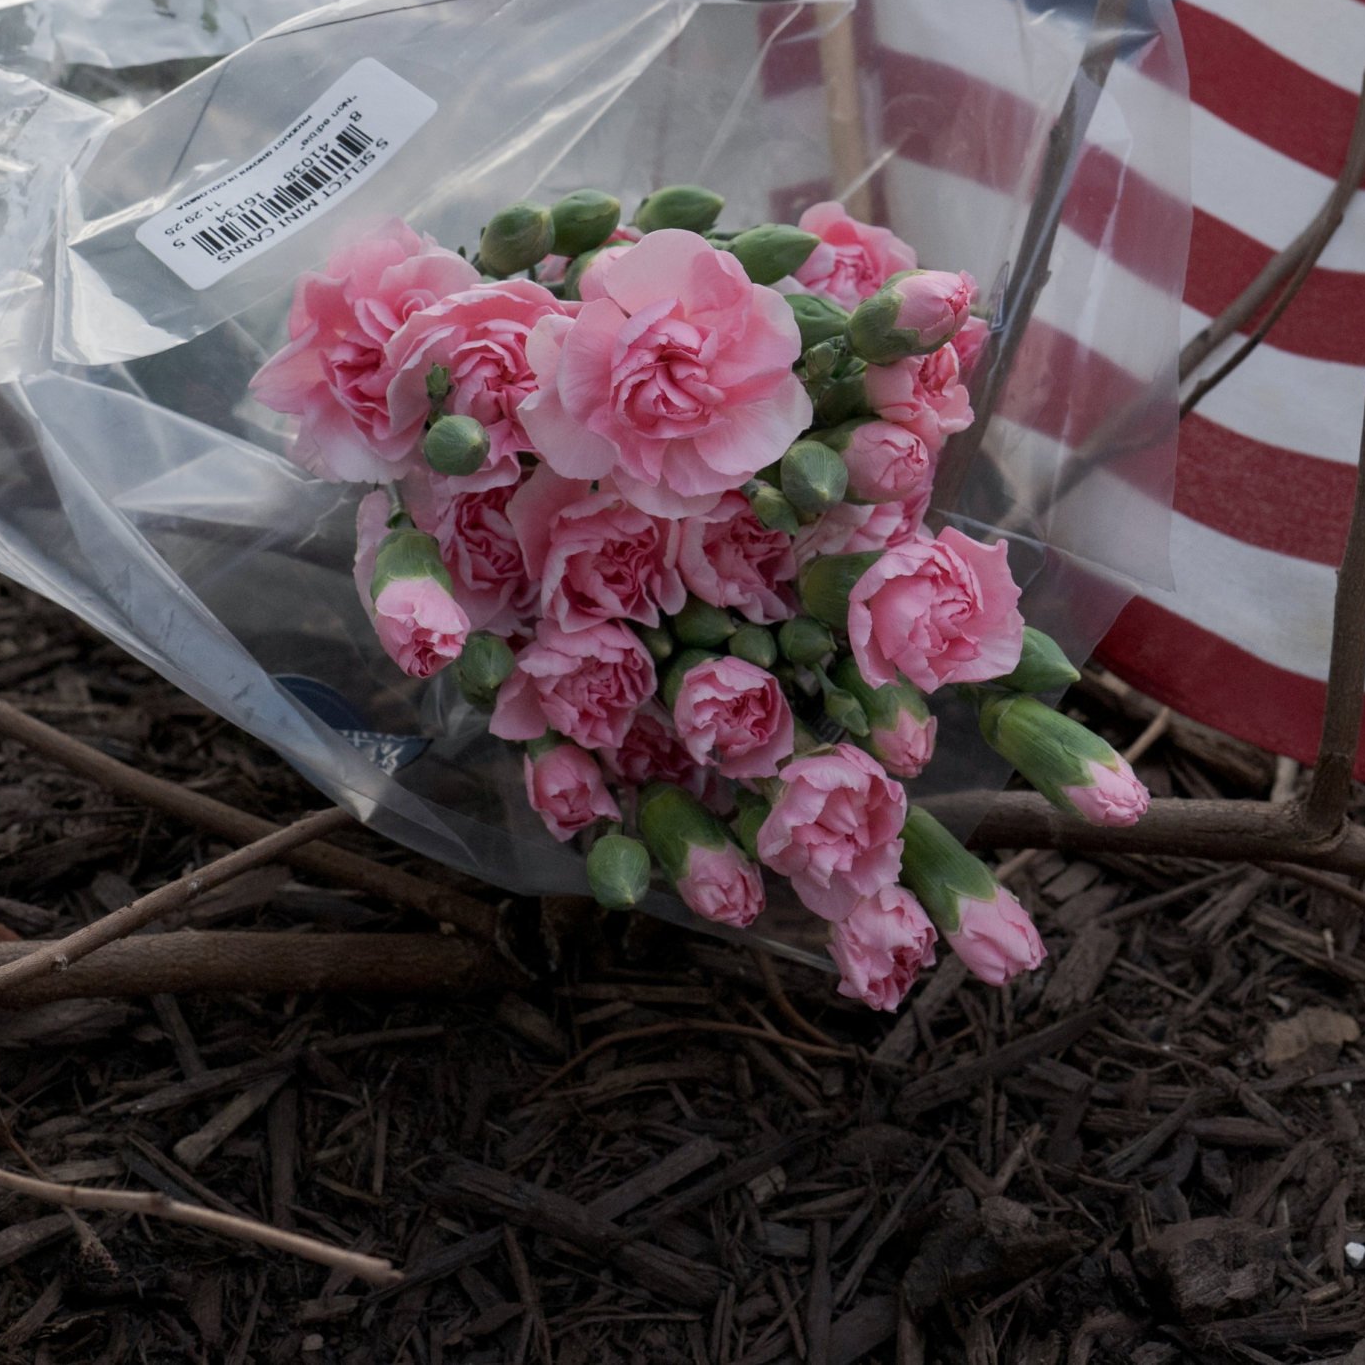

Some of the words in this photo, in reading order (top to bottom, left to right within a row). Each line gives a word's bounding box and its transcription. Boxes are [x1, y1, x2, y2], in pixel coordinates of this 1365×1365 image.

[349, 110, 363, 123] 8
[272, 114, 313, 151] PRODUCT
[375, 138, 389, 151] S
[238, 150, 273, 176] GROWN
[282, 142, 329, 182] 41038
[322, 151, 376, 198] SELECT
[215, 192, 266, 224] 16134
[278, 199, 319, 227] MINI
[172, 239, 186, 249] 5
[217, 228, 275, 264] CARNS
